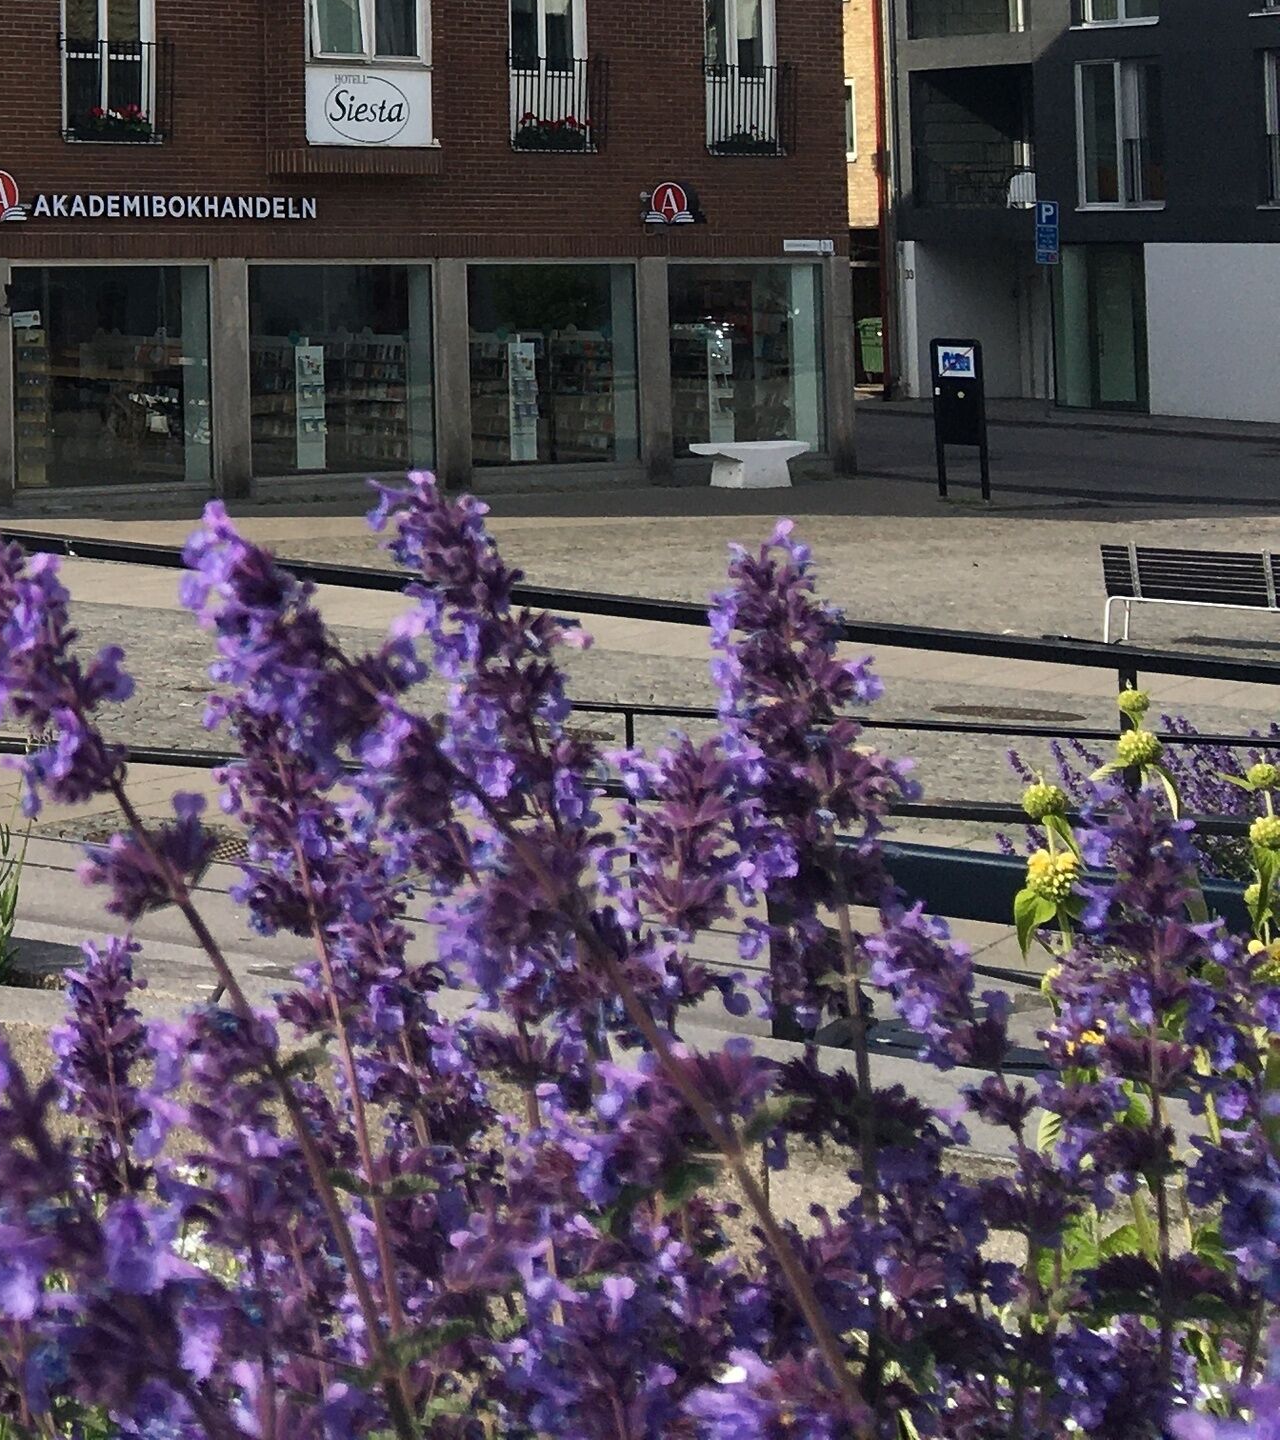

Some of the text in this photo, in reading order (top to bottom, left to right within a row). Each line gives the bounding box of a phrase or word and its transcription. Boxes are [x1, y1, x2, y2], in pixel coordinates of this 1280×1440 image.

[334, 74, 368, 85] HOTELL
[329, 89, 405, 122] Siesta
[33, 194, 317, 219] AKADEMIBOKHANDELN
[1042, 204, 1054, 223] P
